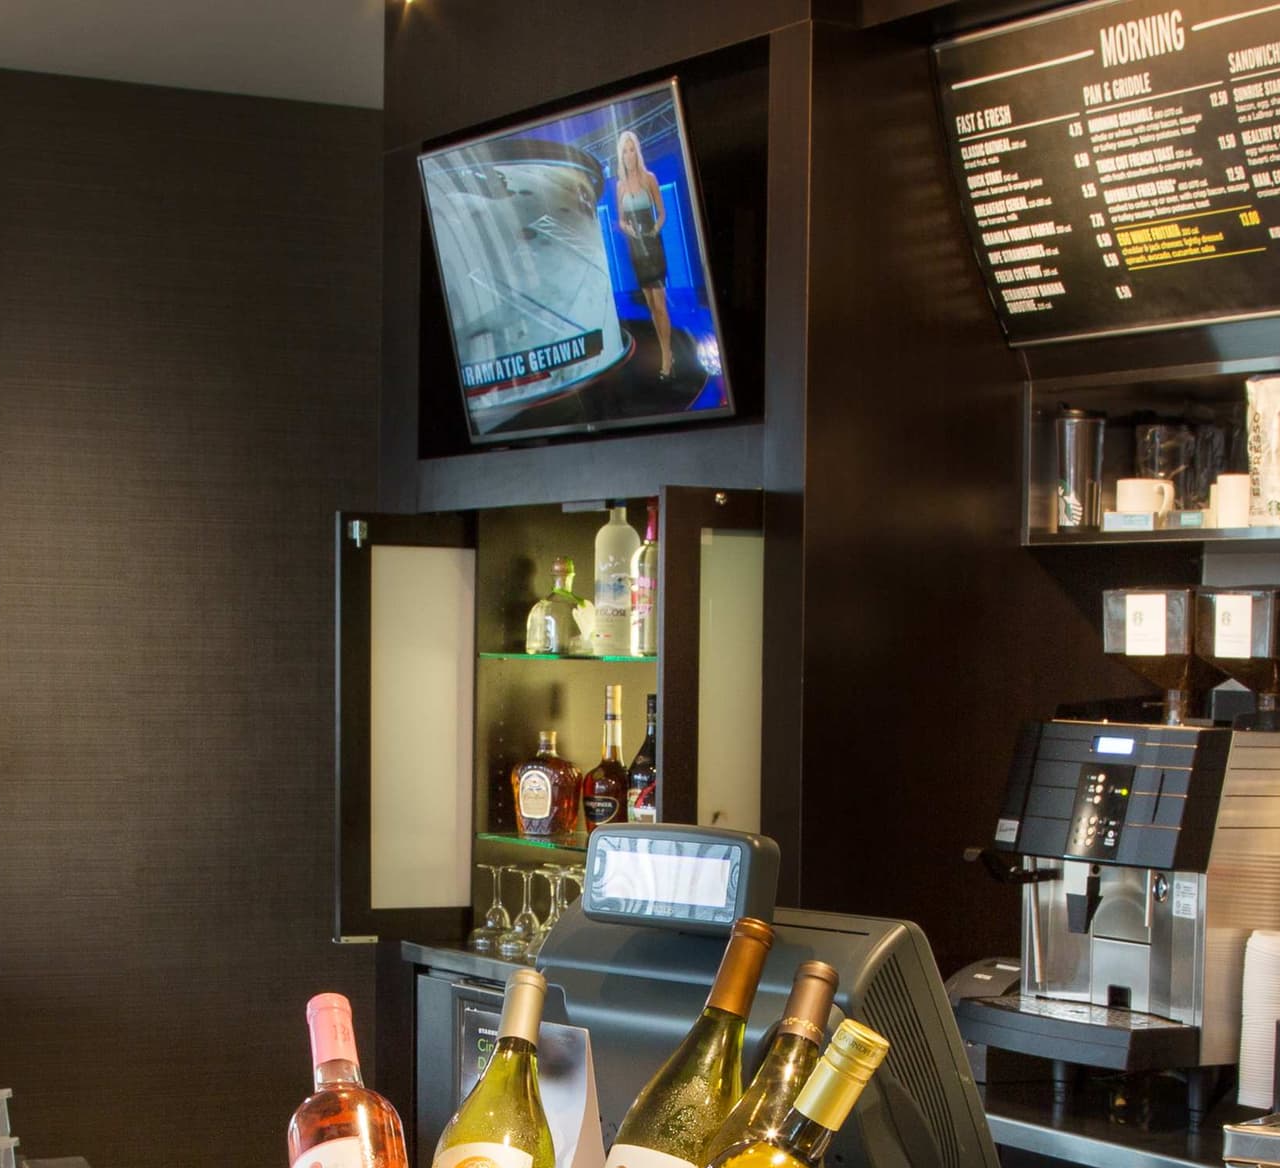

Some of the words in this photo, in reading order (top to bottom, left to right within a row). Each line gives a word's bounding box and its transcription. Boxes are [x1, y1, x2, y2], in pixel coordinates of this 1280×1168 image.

[1100, 9, 1185, 68] MORNING
[1083, 83, 1103, 106] PAN
[1112, 72, 1152, 99] GRIDDLE
[955, 113, 976, 135] FAST
[976, 111, 984, 131] &
[984, 104, 1012, 129] FRESH
[529, 336, 587, 372] GETAWAY
